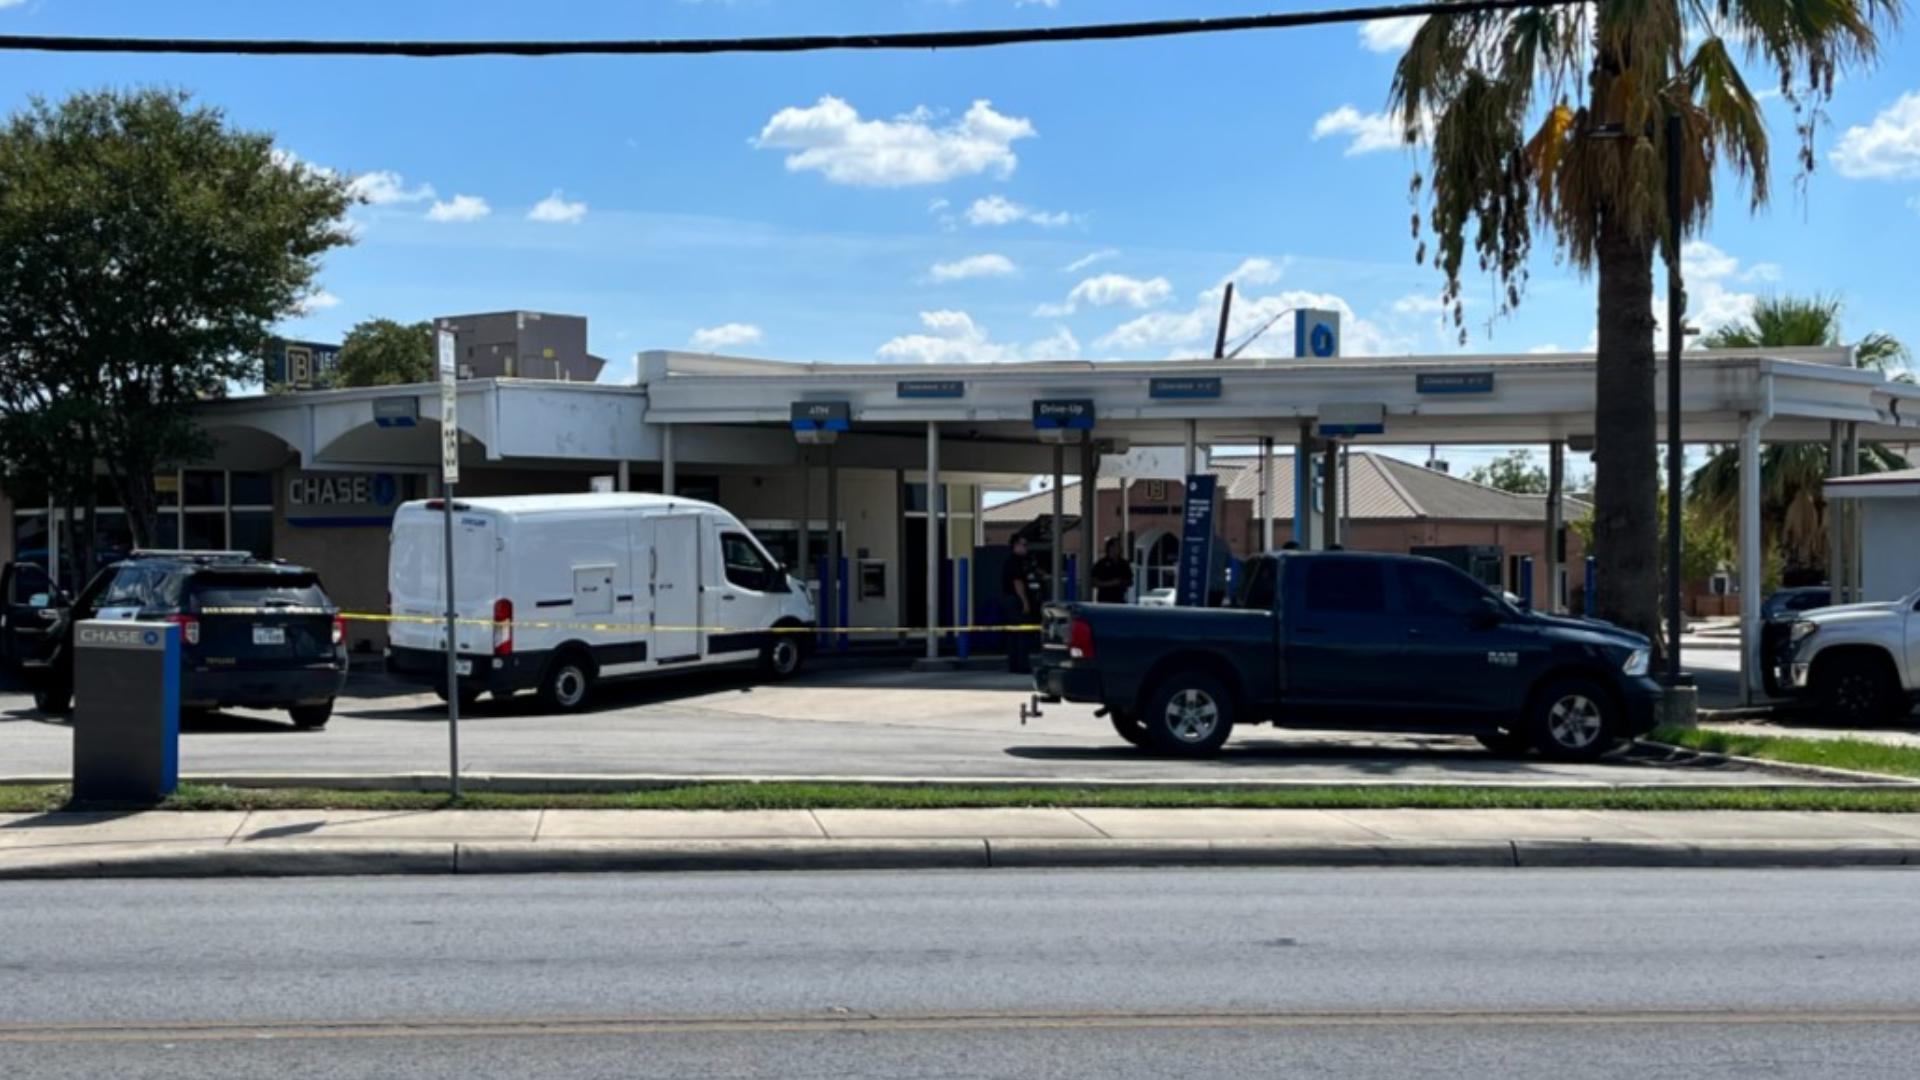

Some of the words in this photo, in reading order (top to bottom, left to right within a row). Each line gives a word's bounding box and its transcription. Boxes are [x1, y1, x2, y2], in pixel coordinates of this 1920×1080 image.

[809, 405, 830, 415] ATM
[1040, 403, 1084, 415] Drive-Up
[288, 477, 368, 504] CHASE
[80, 628, 141, 644] CHASE
